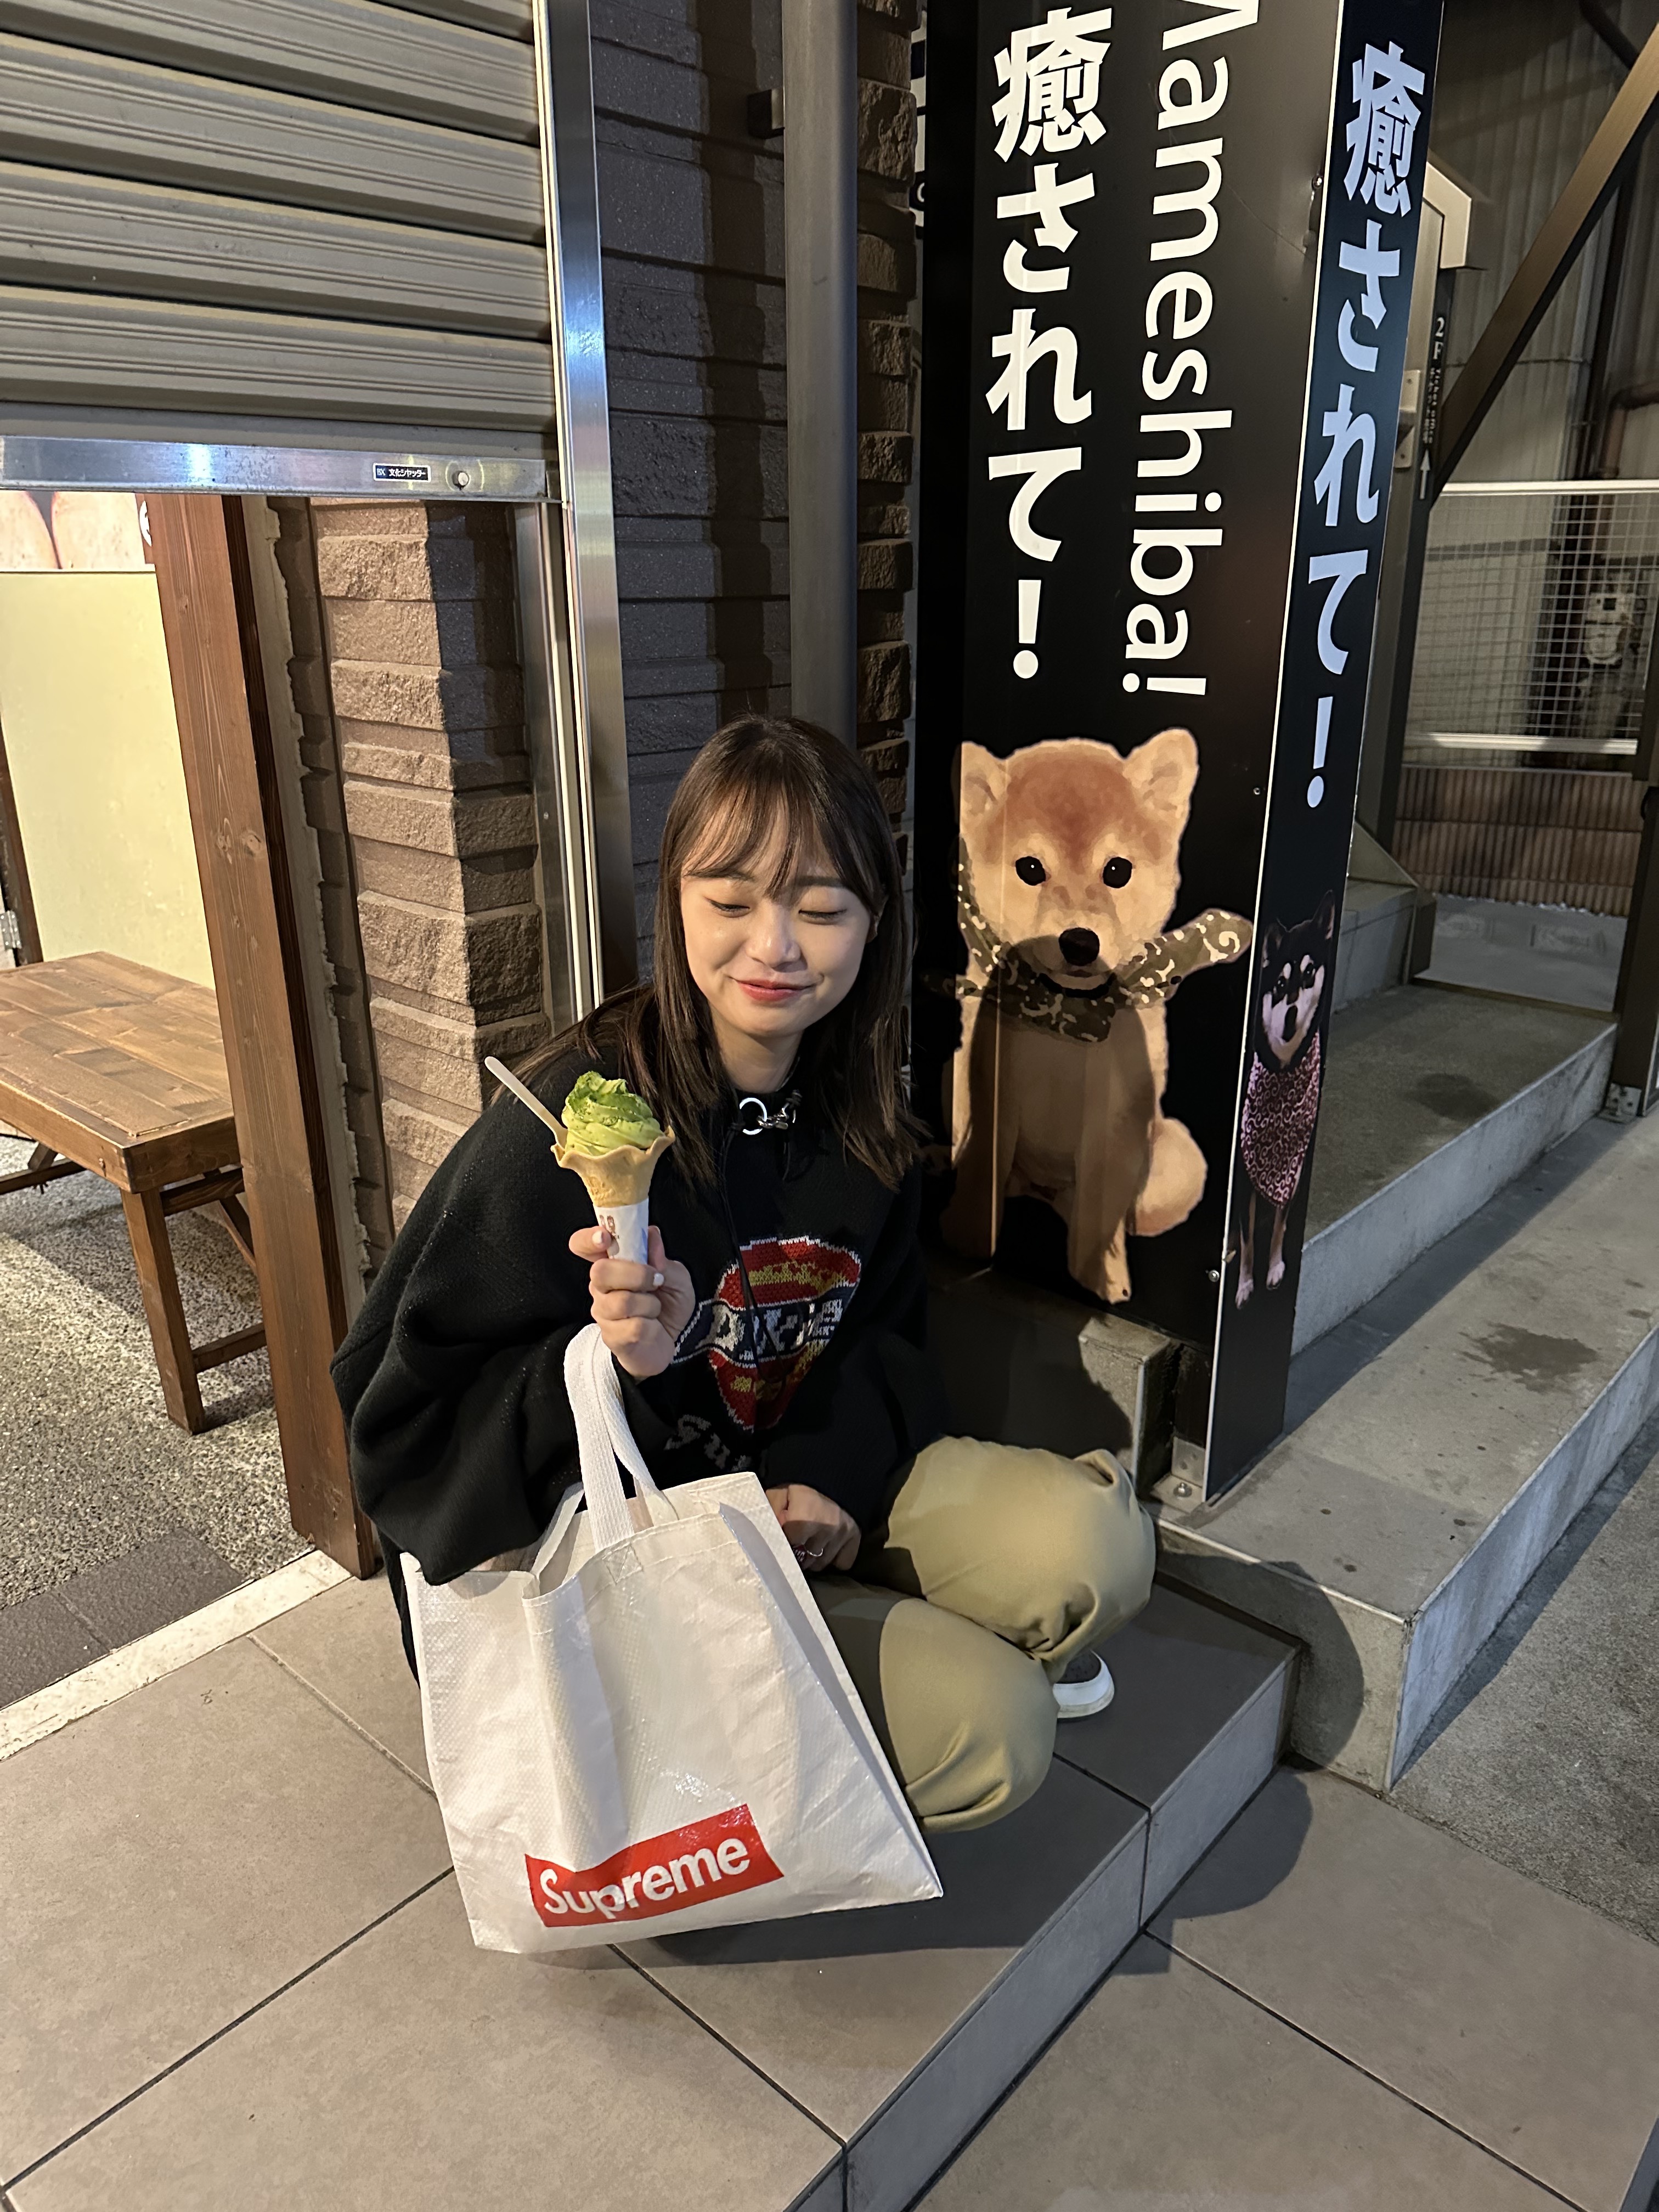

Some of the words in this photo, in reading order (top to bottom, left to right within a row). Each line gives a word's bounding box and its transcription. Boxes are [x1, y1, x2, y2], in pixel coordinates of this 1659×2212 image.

[376, 468, 386, 476] BX
[985, 7, 1112, 679] 癒されて！
[1307, 41, 1425, 808] 癒されて！
[539, 1837, 751, 1920] Supreme
